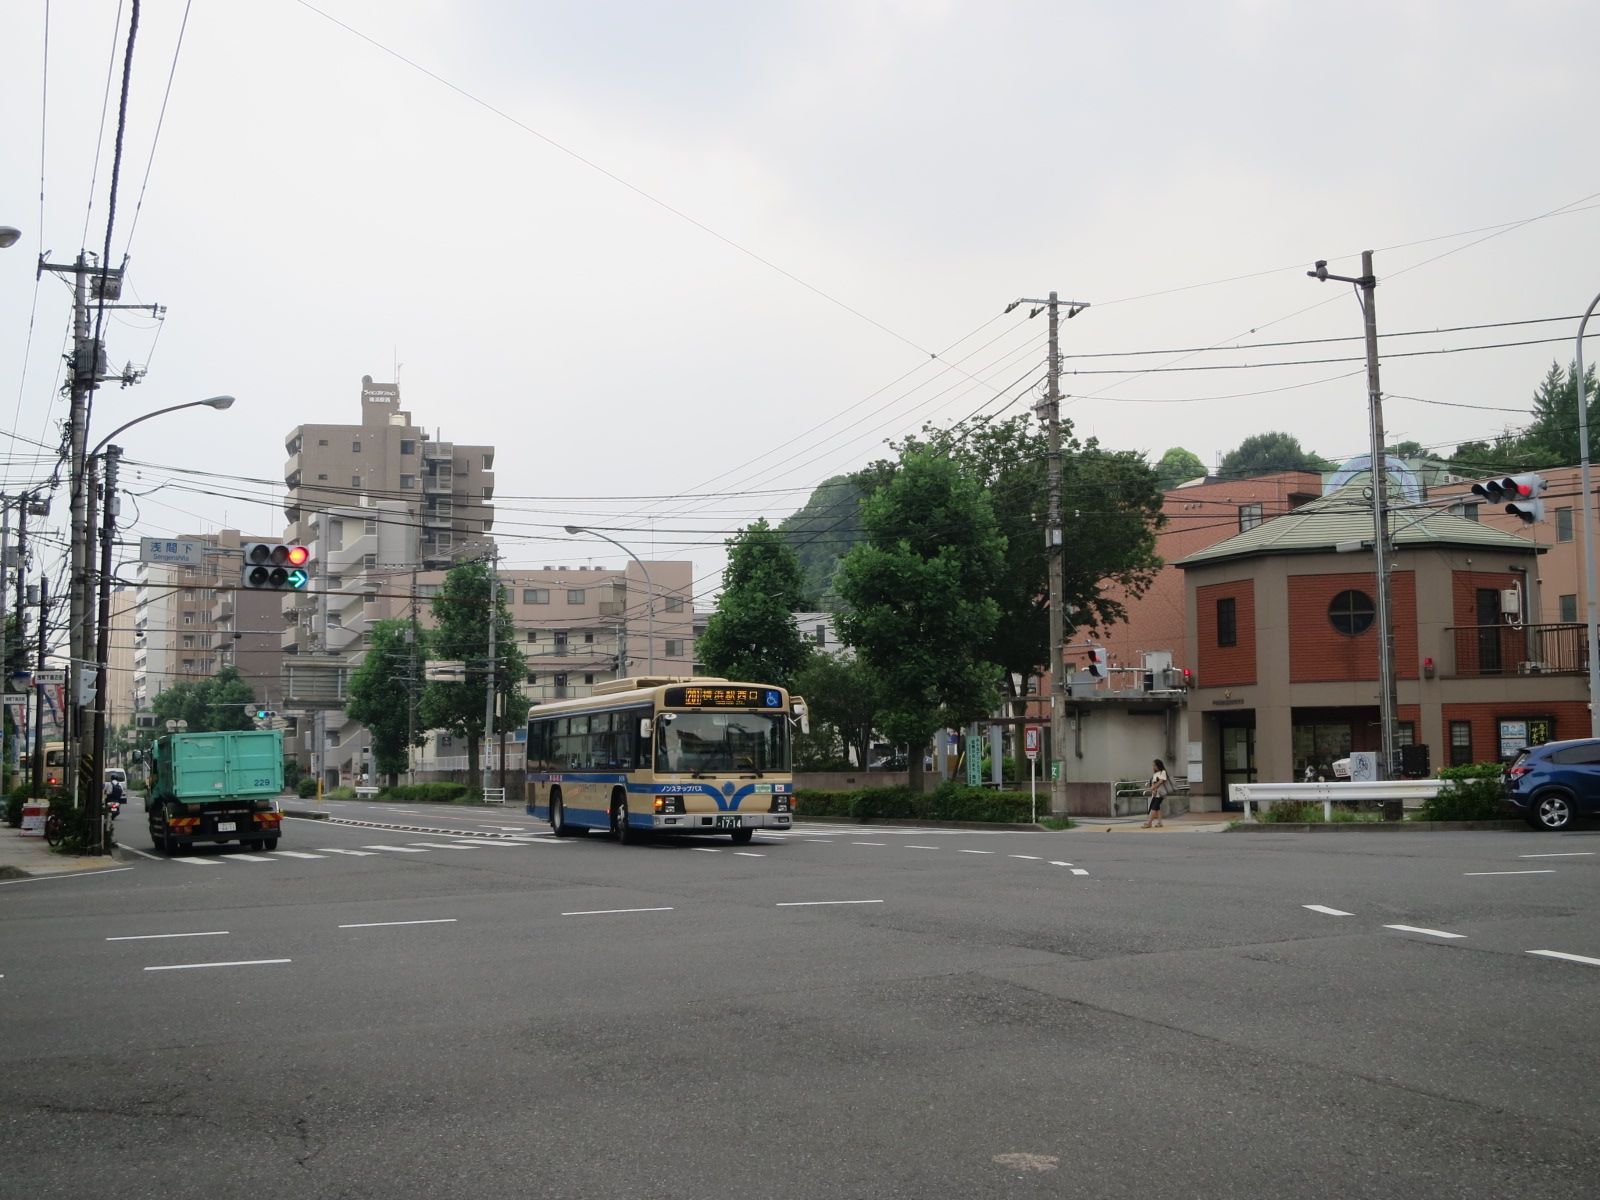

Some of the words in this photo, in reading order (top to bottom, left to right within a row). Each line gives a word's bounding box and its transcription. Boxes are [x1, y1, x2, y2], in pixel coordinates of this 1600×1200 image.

[151, 542, 193, 554] 浅間下
[703, 689, 758, 700] 横浜駅西口
[254, 779, 270, 787] 229
